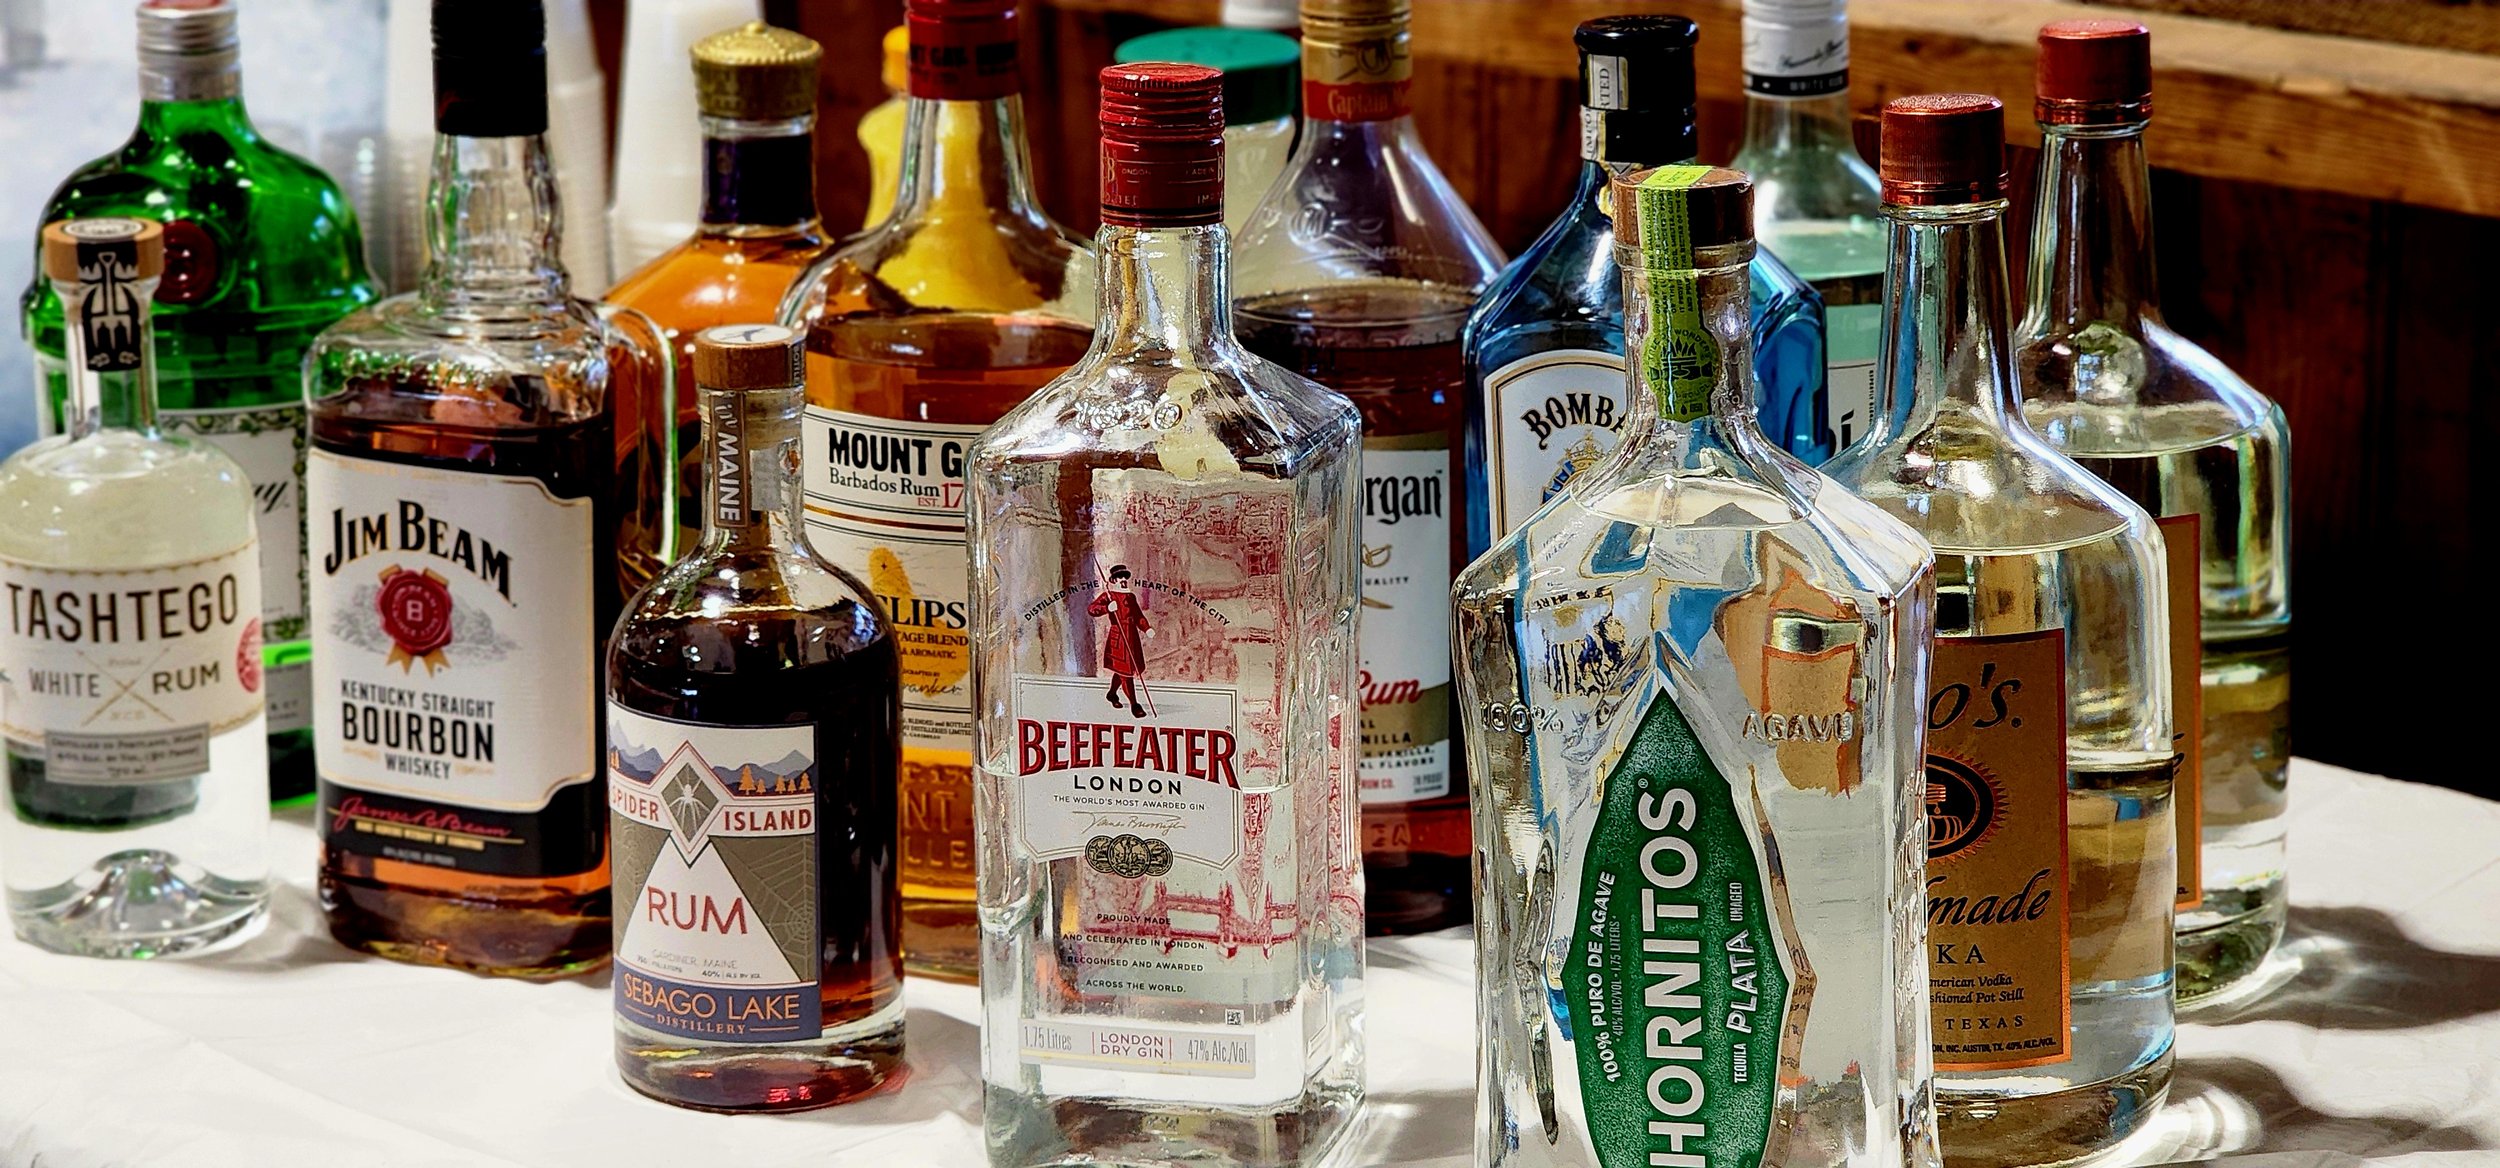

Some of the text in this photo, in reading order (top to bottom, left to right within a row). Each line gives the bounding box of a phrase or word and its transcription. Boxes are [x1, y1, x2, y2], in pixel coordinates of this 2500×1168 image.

[828, 426, 933, 477] MOUNT
[716, 431, 741, 522] MAINE
[829, 466, 940, 497] Barbados Rum
[917, 496, 940, 508] EST.
[1362, 475, 1442, 526] rgan
[325, 499, 514, 602] JIM BEAM
[1365, 576, 1409, 586] UALITY
[5, 572, 238, 644] TASHTEGO
[1024, 578, 1231, 627] DISTILLED IN THE HEART OF THE CITY
[926, 633, 969, 646] BLEND
[909, 648, 957, 659] AROMATIC
[28, 659, 221, 698] WHITE RUM
[341, 678, 495, 719] KENTUCKY STRAIGHT
[1928, 662, 2022, 730] o's
[342, 701, 494, 763] BOURBON
[1361, 732, 1412, 745] NILLA
[385, 753, 452, 780] WHISKEY
[1017, 718, 1242, 791] BEEFEATER
[1074, 774, 1182, 796] LONDON
[611, 786, 813, 833] SPIDER ISLAND
[1053, 794, 1205, 811] THE WORLD'S MOST AWARDED GIN
[646, 885, 748, 936] RUM
[1927, 867, 2052, 927] made
[1097, 913, 1171, 926] PROUDLY MADE
[1062, 933, 1209, 951] AND CELEBRATED IN LONDON.
[702, 970, 721, 978] 40%
[1067, 955, 1204, 973] RECOGNISED AND AWARDED
[1587, 870, 1622, 1083] 100% PURO DE AGAVE
[1638, 787, 1706, 1168] HORNITOS
[1086, 979, 1187, 994] ACROSS THE WORLD.
[1608, 921, 1624, 1037] 40% ALC/VOL 1.75 LITERS
[1726, 882, 1759, 1085] TEQUILA PLATA UNAGED
[1930, 973, 2014, 989] merican Vodka
[624, 972, 800, 1021] SEBAGO LAKE
[1930, 988, 2025, 1005] shioned Pot Still
[656, 1013, 746, 1035] DISTILLERY
[1944, 1014, 2025, 1031] TEXAS
[1023, 1026, 1073, 1051] 1.75 Litres
[1100, 1032, 1164, 1048] LONDON
[1100, 1044, 1164, 1059] DRY GIN
[1187, 1038, 1210, 1061] 47%
